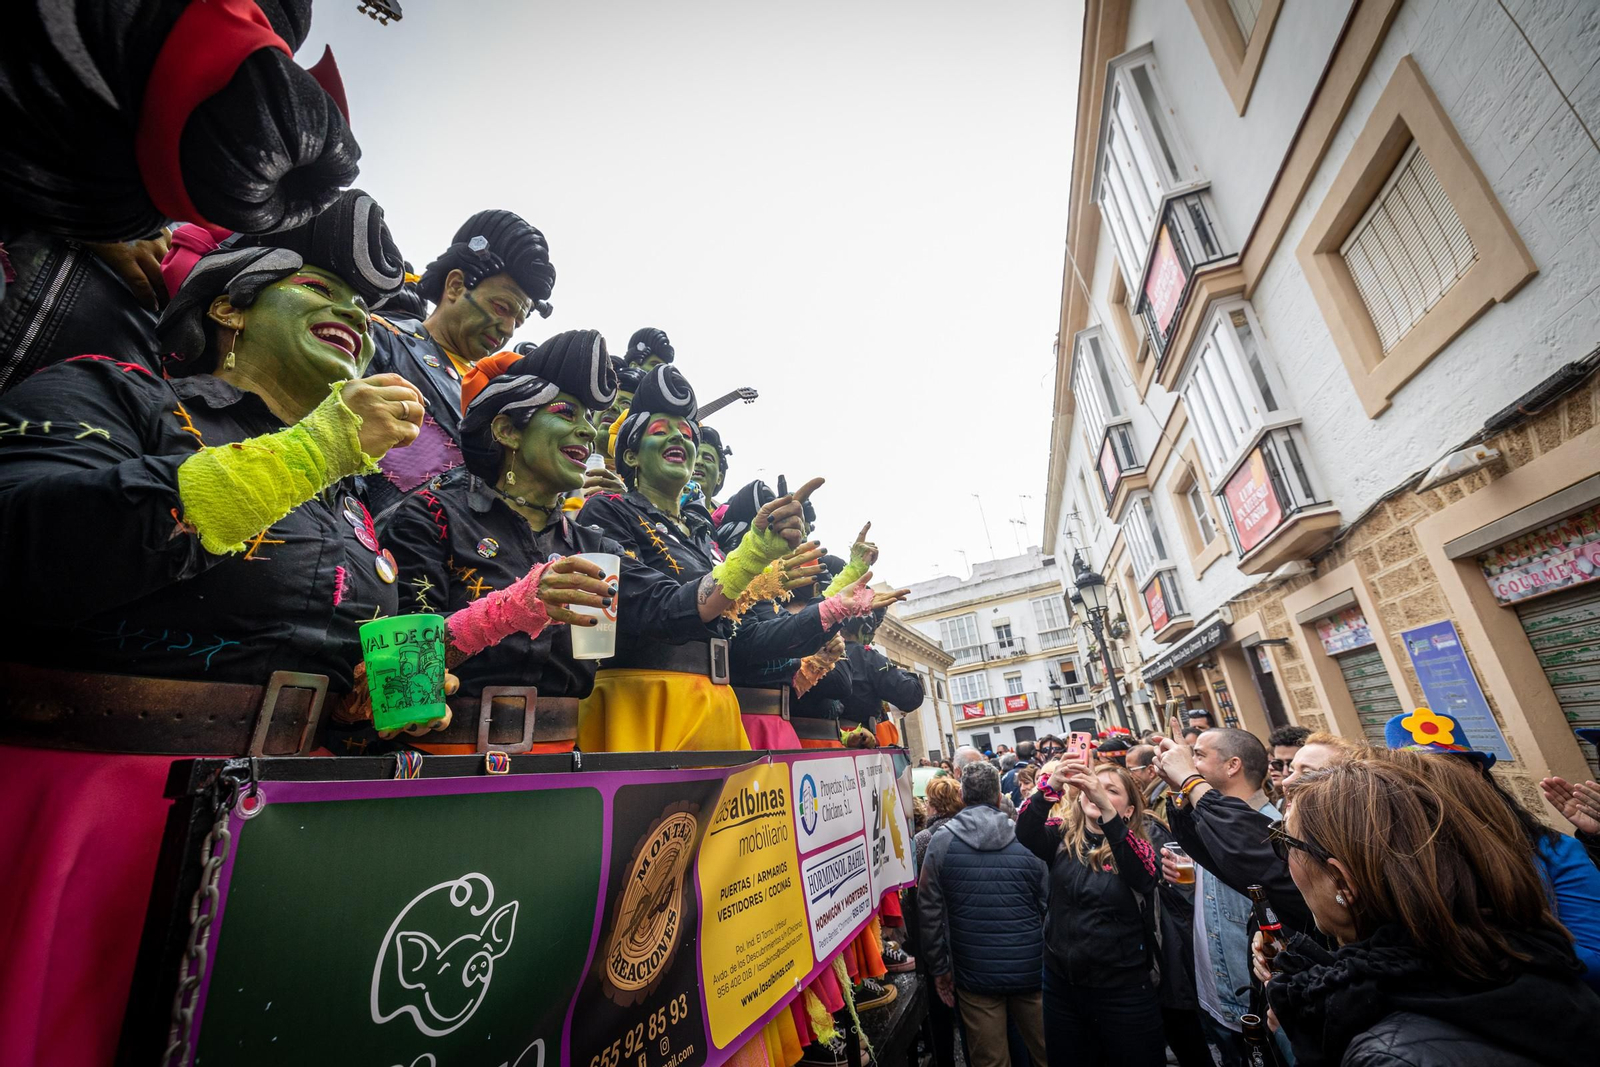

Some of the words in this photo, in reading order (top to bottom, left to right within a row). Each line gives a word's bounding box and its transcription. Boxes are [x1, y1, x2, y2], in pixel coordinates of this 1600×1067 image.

[1497, 560, 1580, 597] GOURMET
[394, 629, 418, 646] DE
[636, 822, 692, 884] MONTAJ
[739, 821, 788, 857] mobiliario
[720, 877, 751, 901] PUERTAS
[757, 861, 787, 884] ARMARIOS
[807, 858, 847, 896] HORMINSOL
[717, 891, 763, 922] VESTIDORES
[768, 877, 791, 898] COCINAS
[840, 899, 845, 911] Y
[845, 883, 868, 908] MORTEROS
[611, 908, 677, 982] CREACIONES
[713, 970, 729, 985] Avda.
[729, 963, 738, 974] de
[737, 959, 746, 969] los
[745, 937, 781, 964] Descubrimientos
[735, 943, 745, 955] Pol.
[746, 937, 755, 950] Ind.
[755, 932, 762, 944] El
[717, 982, 730, 998] 956
[730, 974, 742, 989] 402
[740, 959, 795, 1007] www.lasalbinas.com
[625, 1023, 644, 1058] 92
[648, 1006, 667, 1040] 85
[669, 993, 688, 1025] 93
